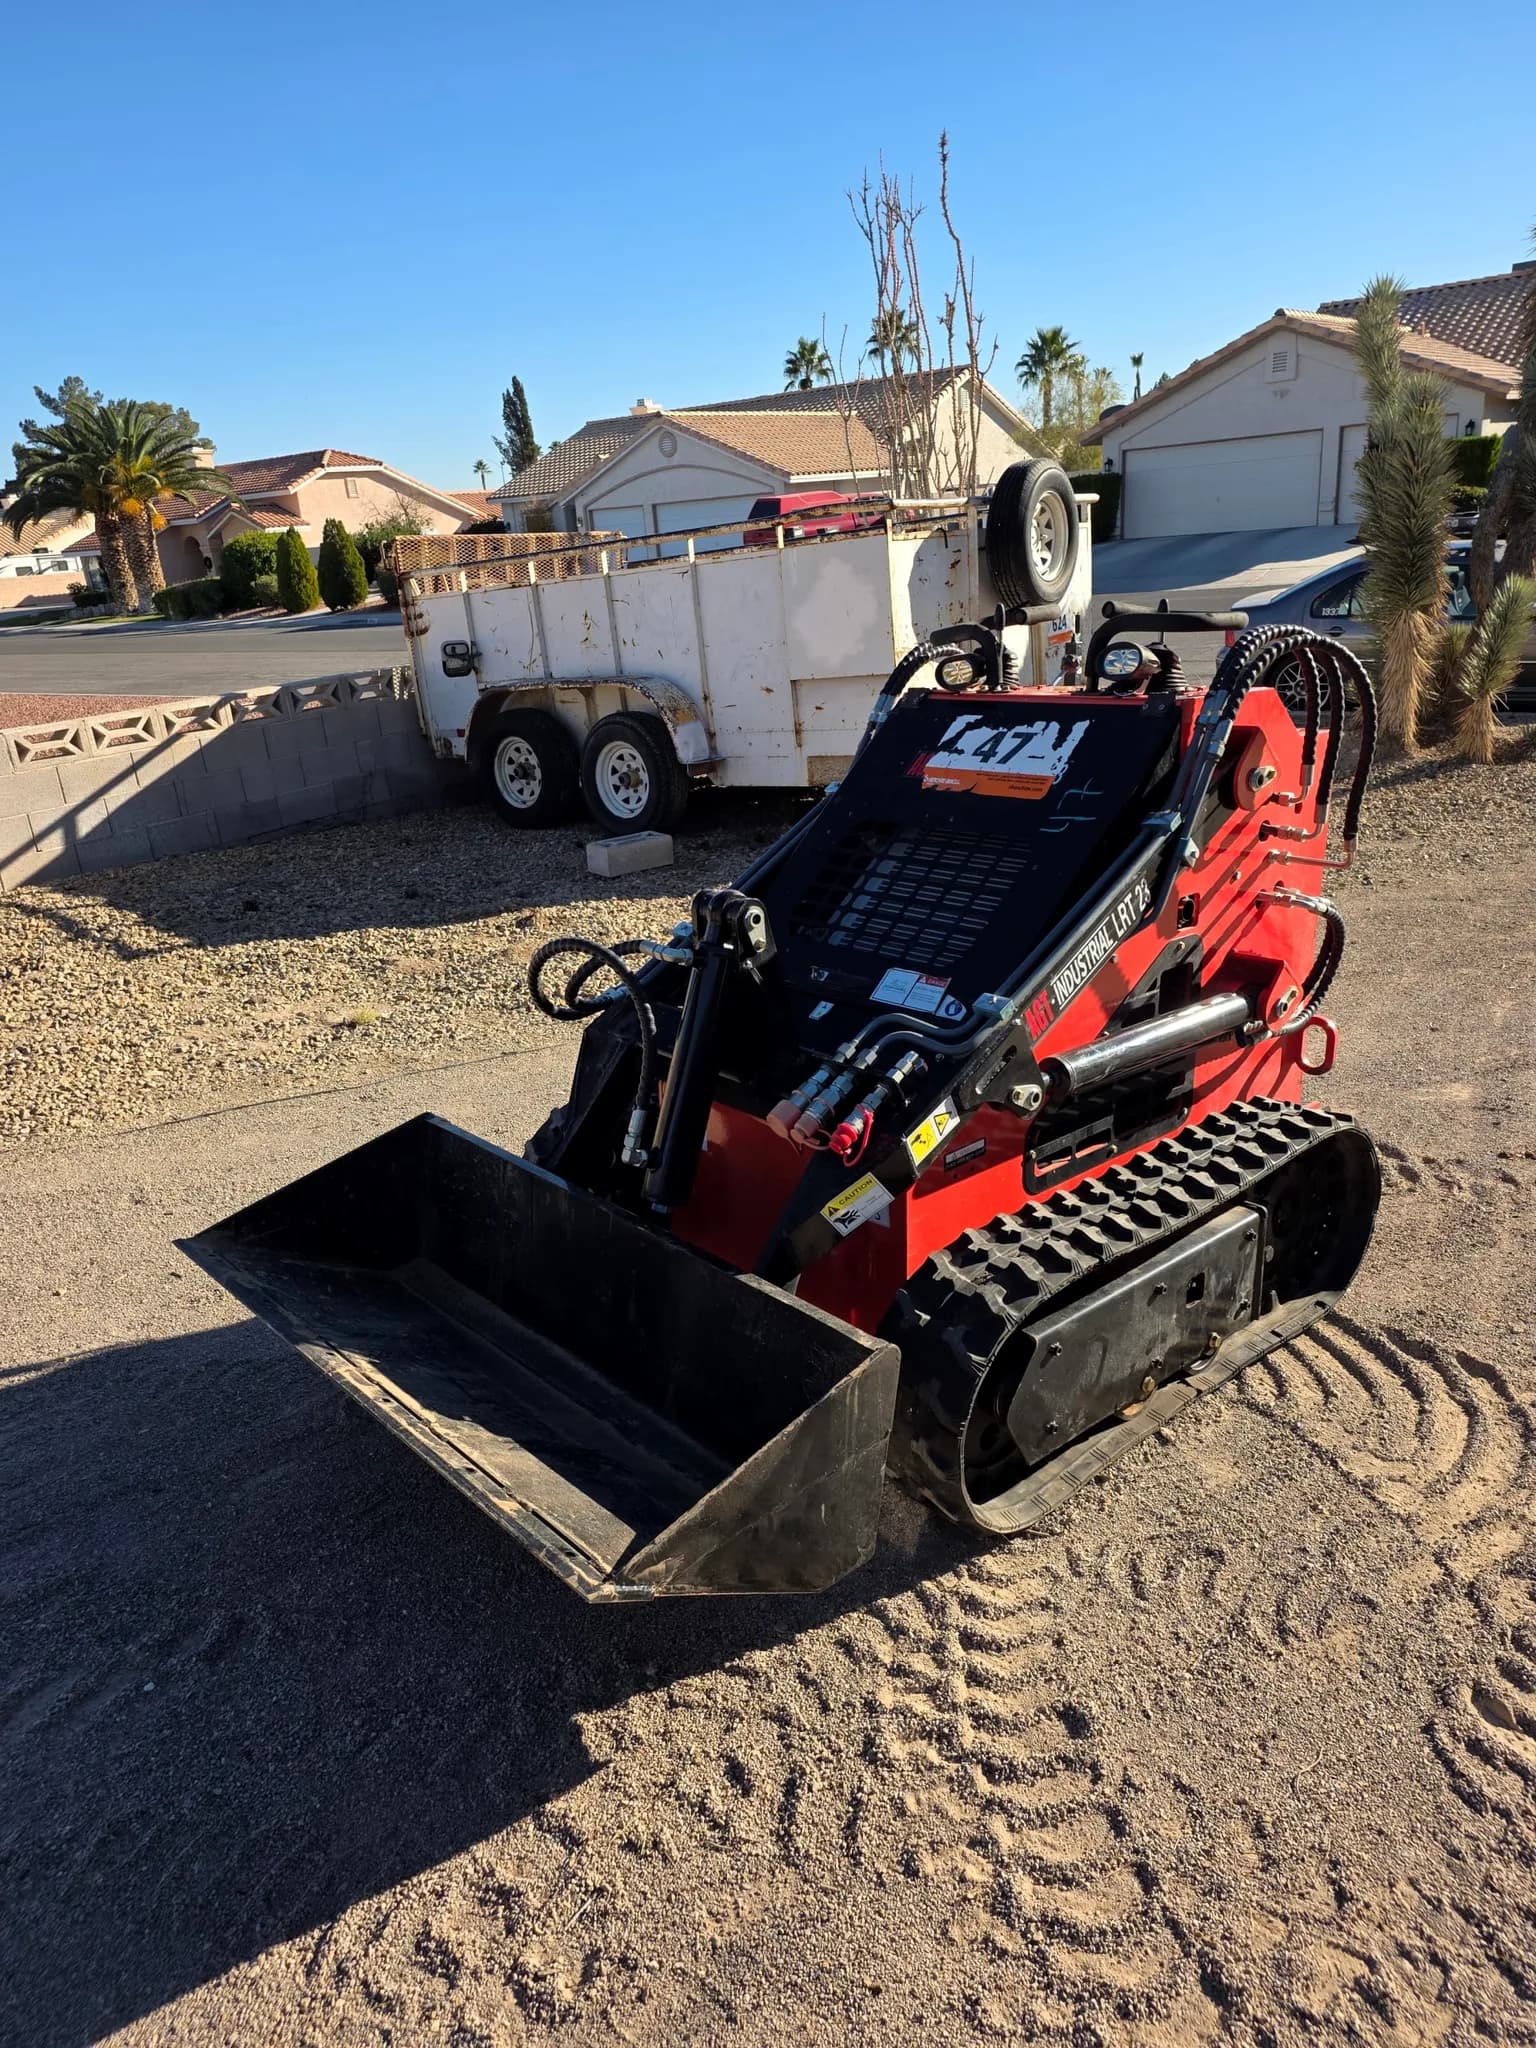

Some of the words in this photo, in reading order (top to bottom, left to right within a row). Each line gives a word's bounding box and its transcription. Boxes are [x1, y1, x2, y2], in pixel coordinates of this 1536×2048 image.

[1052, 614, 1067, 631] 624
[971, 731, 1038, 765] 47
[1111, 893, 1136, 938] LRT
[838, 1178, 873, 1205] CAUTION
